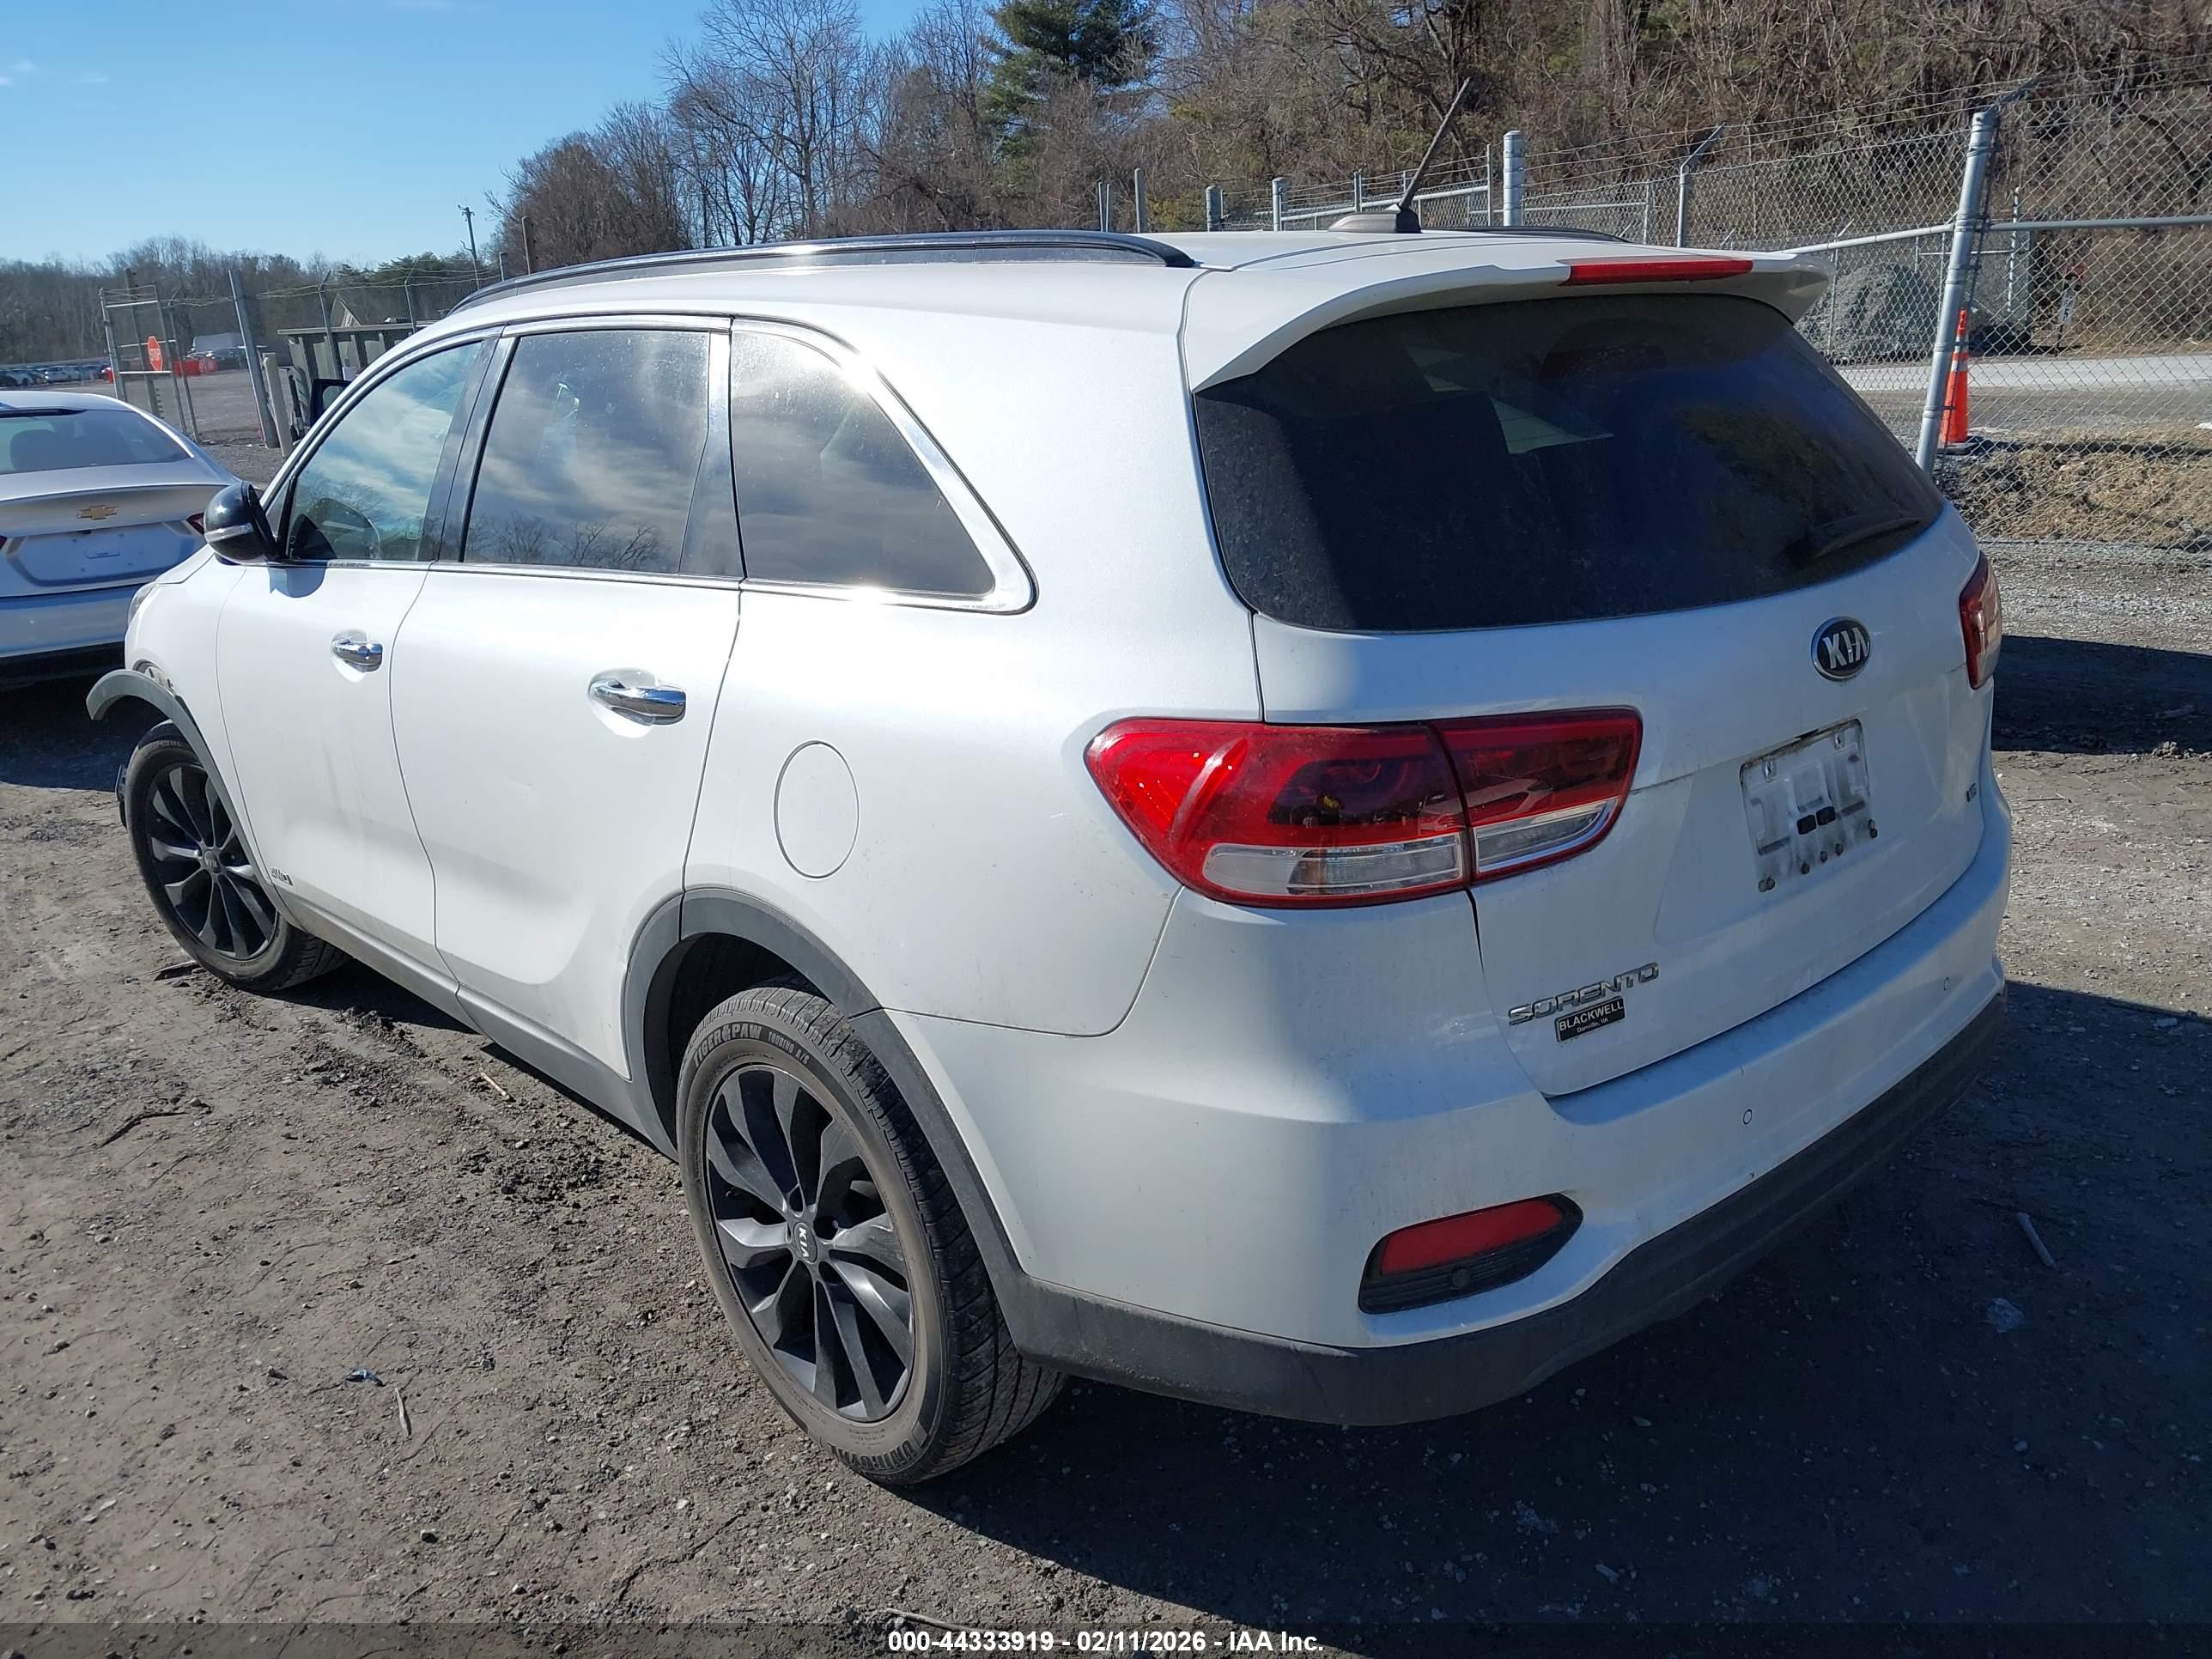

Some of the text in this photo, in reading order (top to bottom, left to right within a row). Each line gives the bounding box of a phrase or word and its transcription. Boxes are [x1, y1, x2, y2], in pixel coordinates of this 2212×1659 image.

[1822, 627, 1869, 669] KIA
[1508, 962, 1660, 1026] SORENTO
[1559, 1000, 1624, 1031] BLACKWELL
[694, 1029, 722, 1068] TIGER
[732, 1023, 763, 1040] PAW
[795, 1049, 810, 1066] A/S
[799, 1227, 810, 1257] KIA
